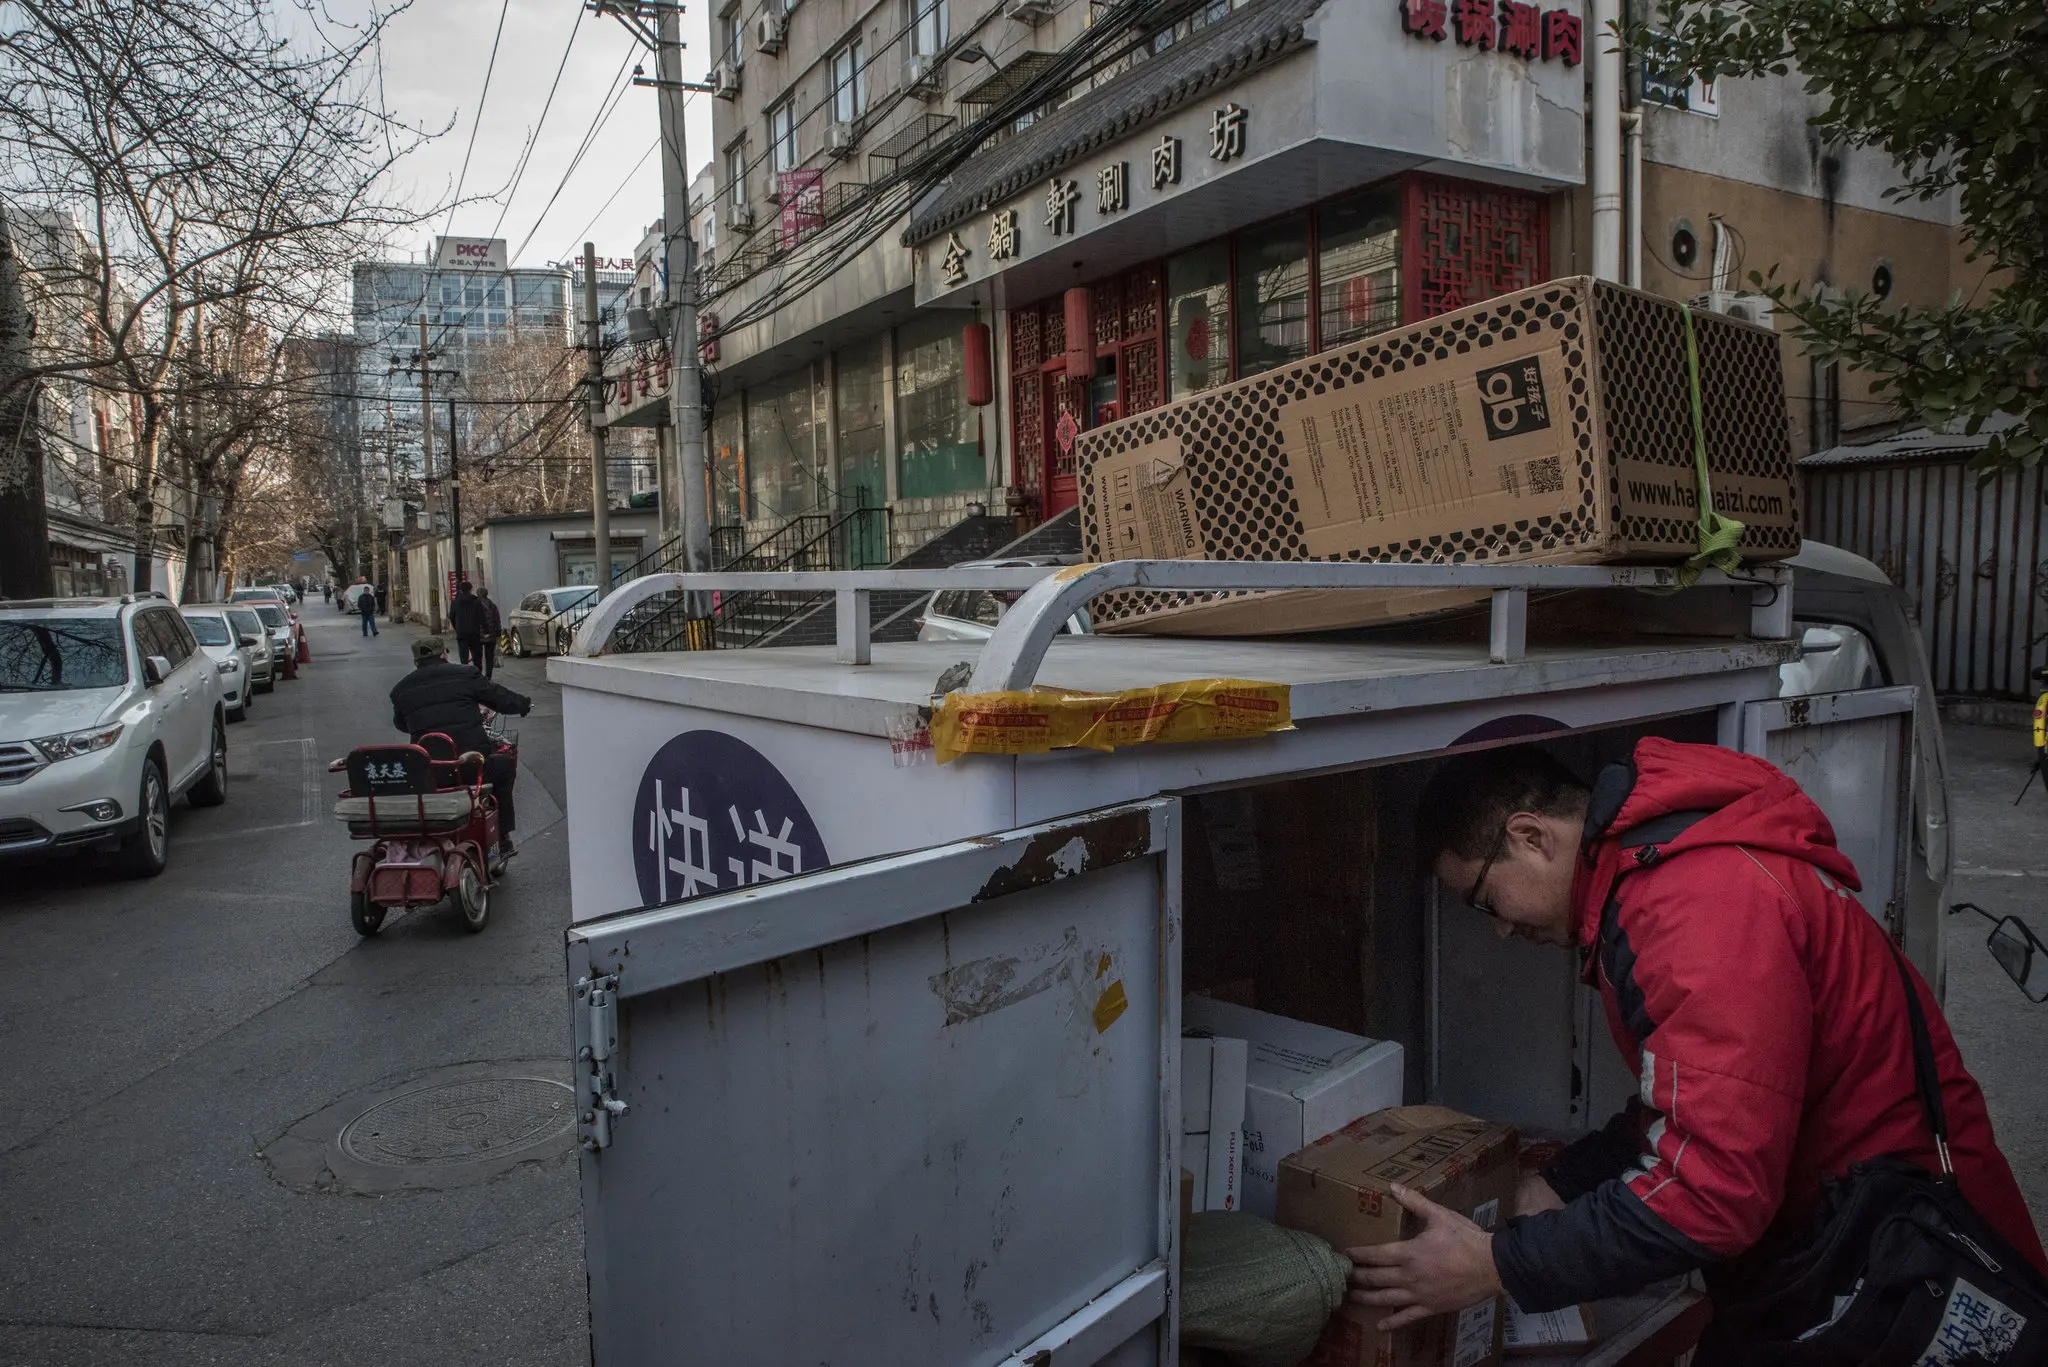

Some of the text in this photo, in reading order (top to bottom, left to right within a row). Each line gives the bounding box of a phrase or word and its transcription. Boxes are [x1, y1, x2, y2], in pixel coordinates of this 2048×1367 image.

[456, 244, 488, 257] PICC
[575, 256, 636, 271] 中国人民
[1522, 365, 1546, 421] 好孩子
[1354, 403, 1366, 439] GOODBABY
[1367, 461, 1378, 494] PRODUCTS
[1174, 487, 1196, 549] WARNING
